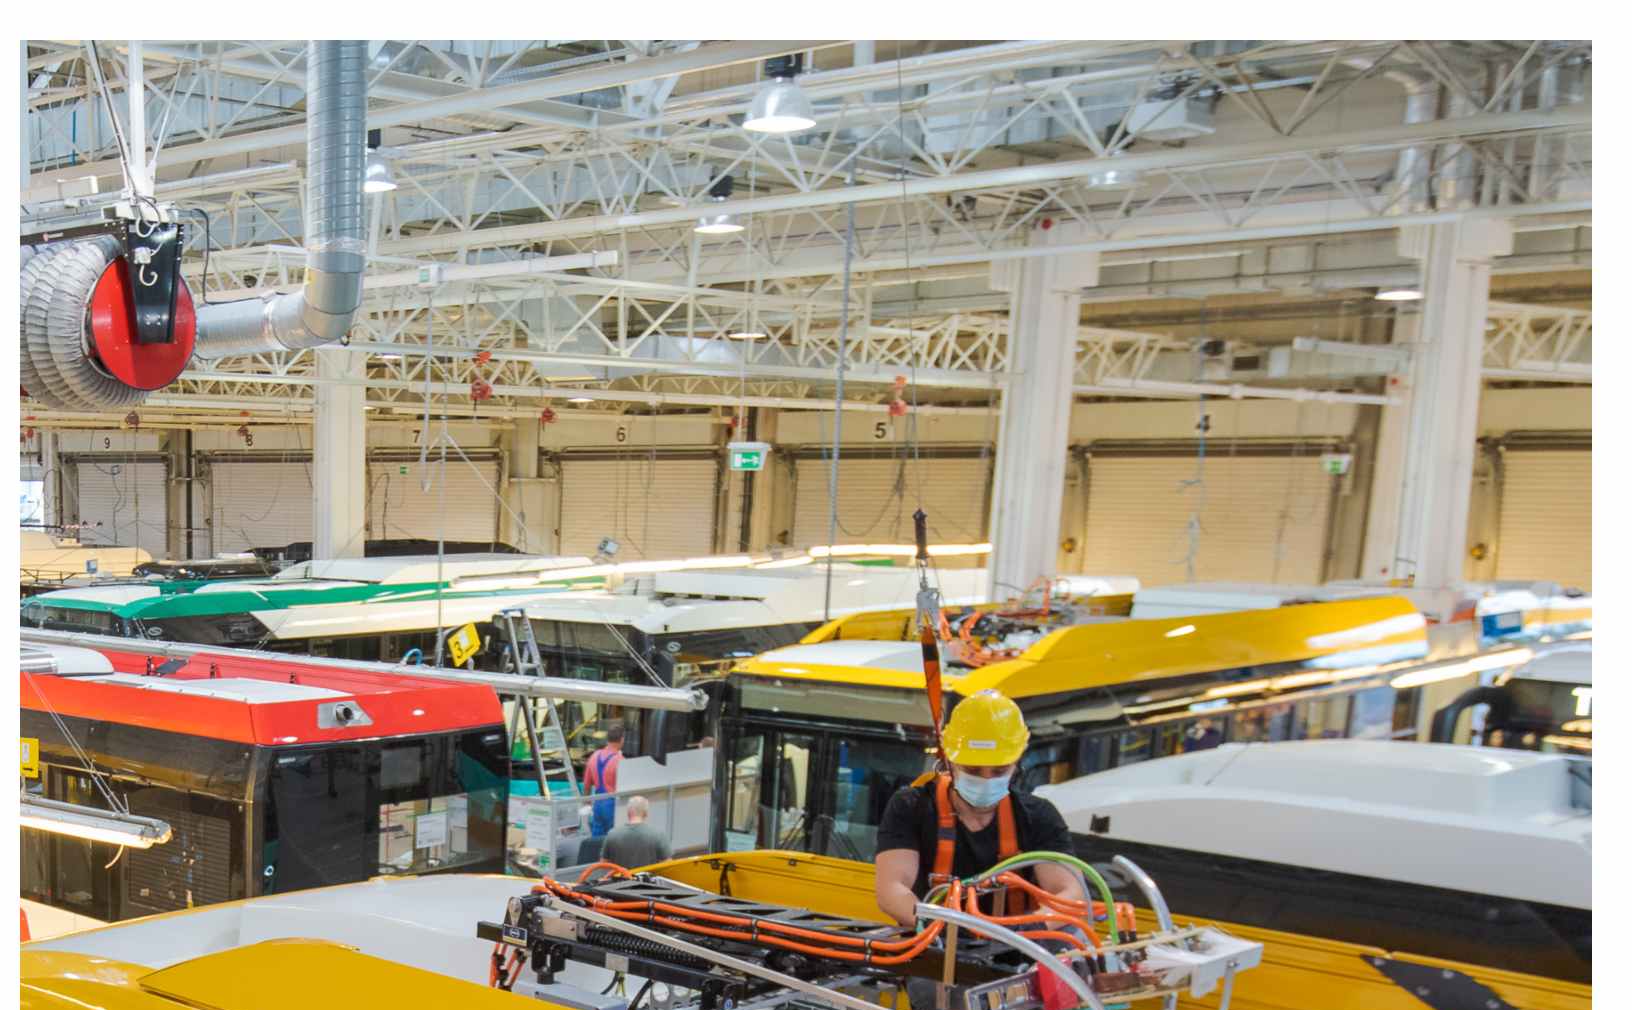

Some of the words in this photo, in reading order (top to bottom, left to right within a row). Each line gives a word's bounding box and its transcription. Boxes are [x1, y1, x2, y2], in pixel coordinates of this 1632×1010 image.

[412, 429, 421, 444] 7
[616, 426, 626, 442] 6
[874, 421, 887, 439] 5
[103, 436, 111, 449] 9
[245, 433, 254, 447] 8
